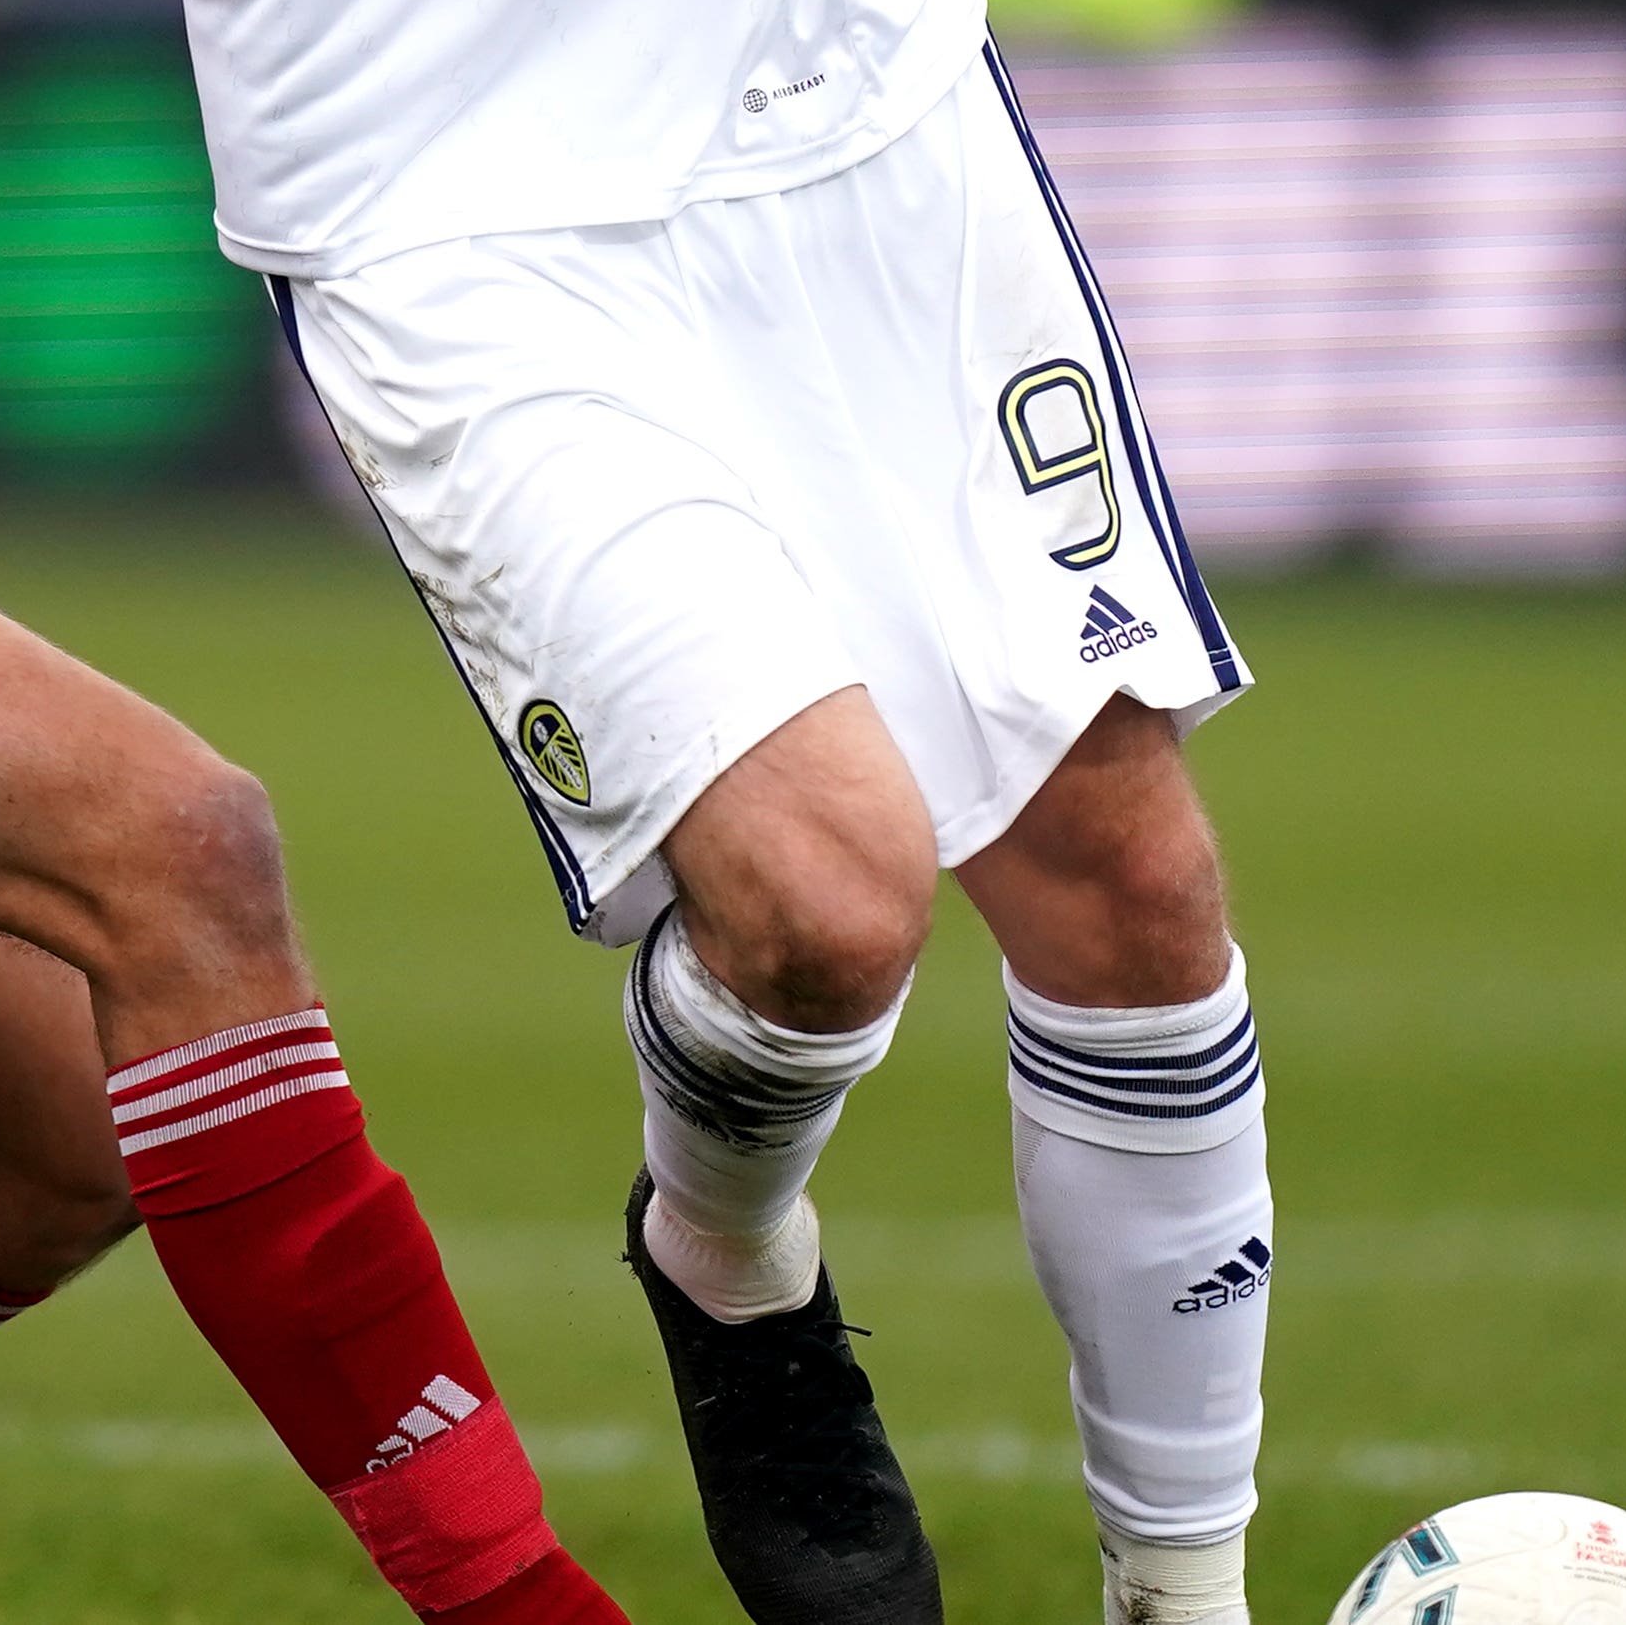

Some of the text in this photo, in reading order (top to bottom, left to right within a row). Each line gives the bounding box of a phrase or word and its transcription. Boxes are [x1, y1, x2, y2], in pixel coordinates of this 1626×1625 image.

[997, 358, 1121, 571] 9
[1080, 620, 1158, 663] adidas
[1173, 1266, 1271, 1314] adida
